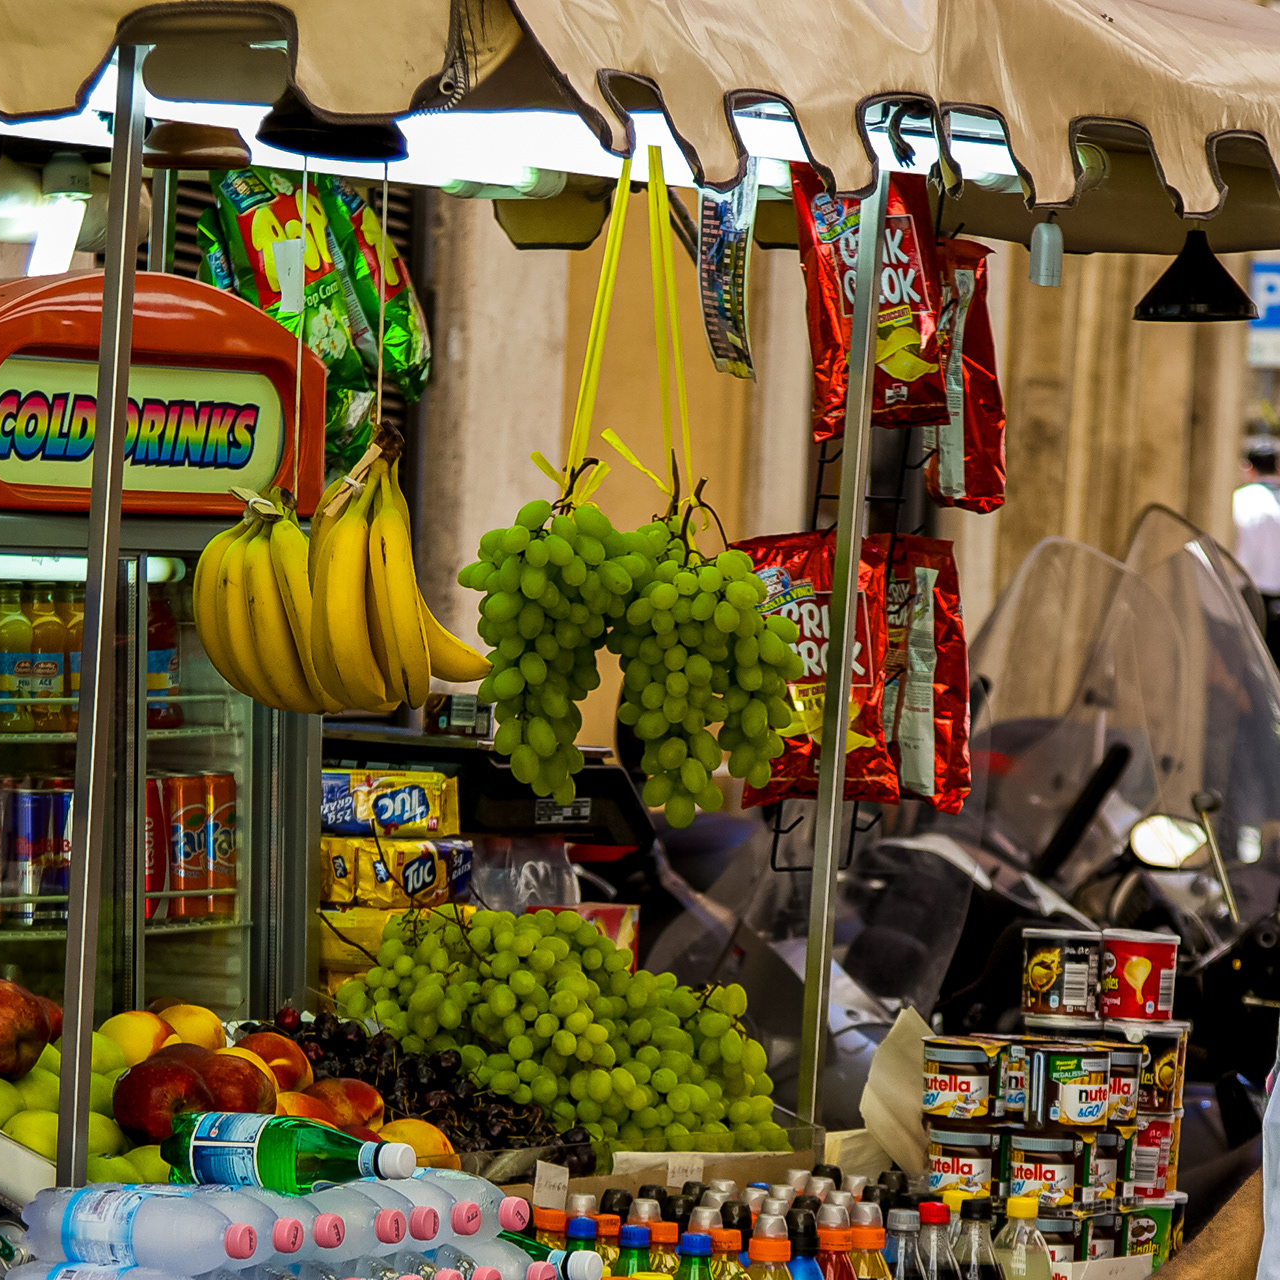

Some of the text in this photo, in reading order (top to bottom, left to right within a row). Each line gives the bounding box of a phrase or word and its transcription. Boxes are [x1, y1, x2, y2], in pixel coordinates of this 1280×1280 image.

[781, 601, 832, 640] CRI
[377, 788, 426, 821] TUC
[404, 861, 434, 894] TUC
[1079, 1085, 1108, 1104] nute
[1077, 1101, 1104, 1118] &GO!
[931, 1157, 973, 1176] utella
[1011, 1163, 1056, 1182] utella
